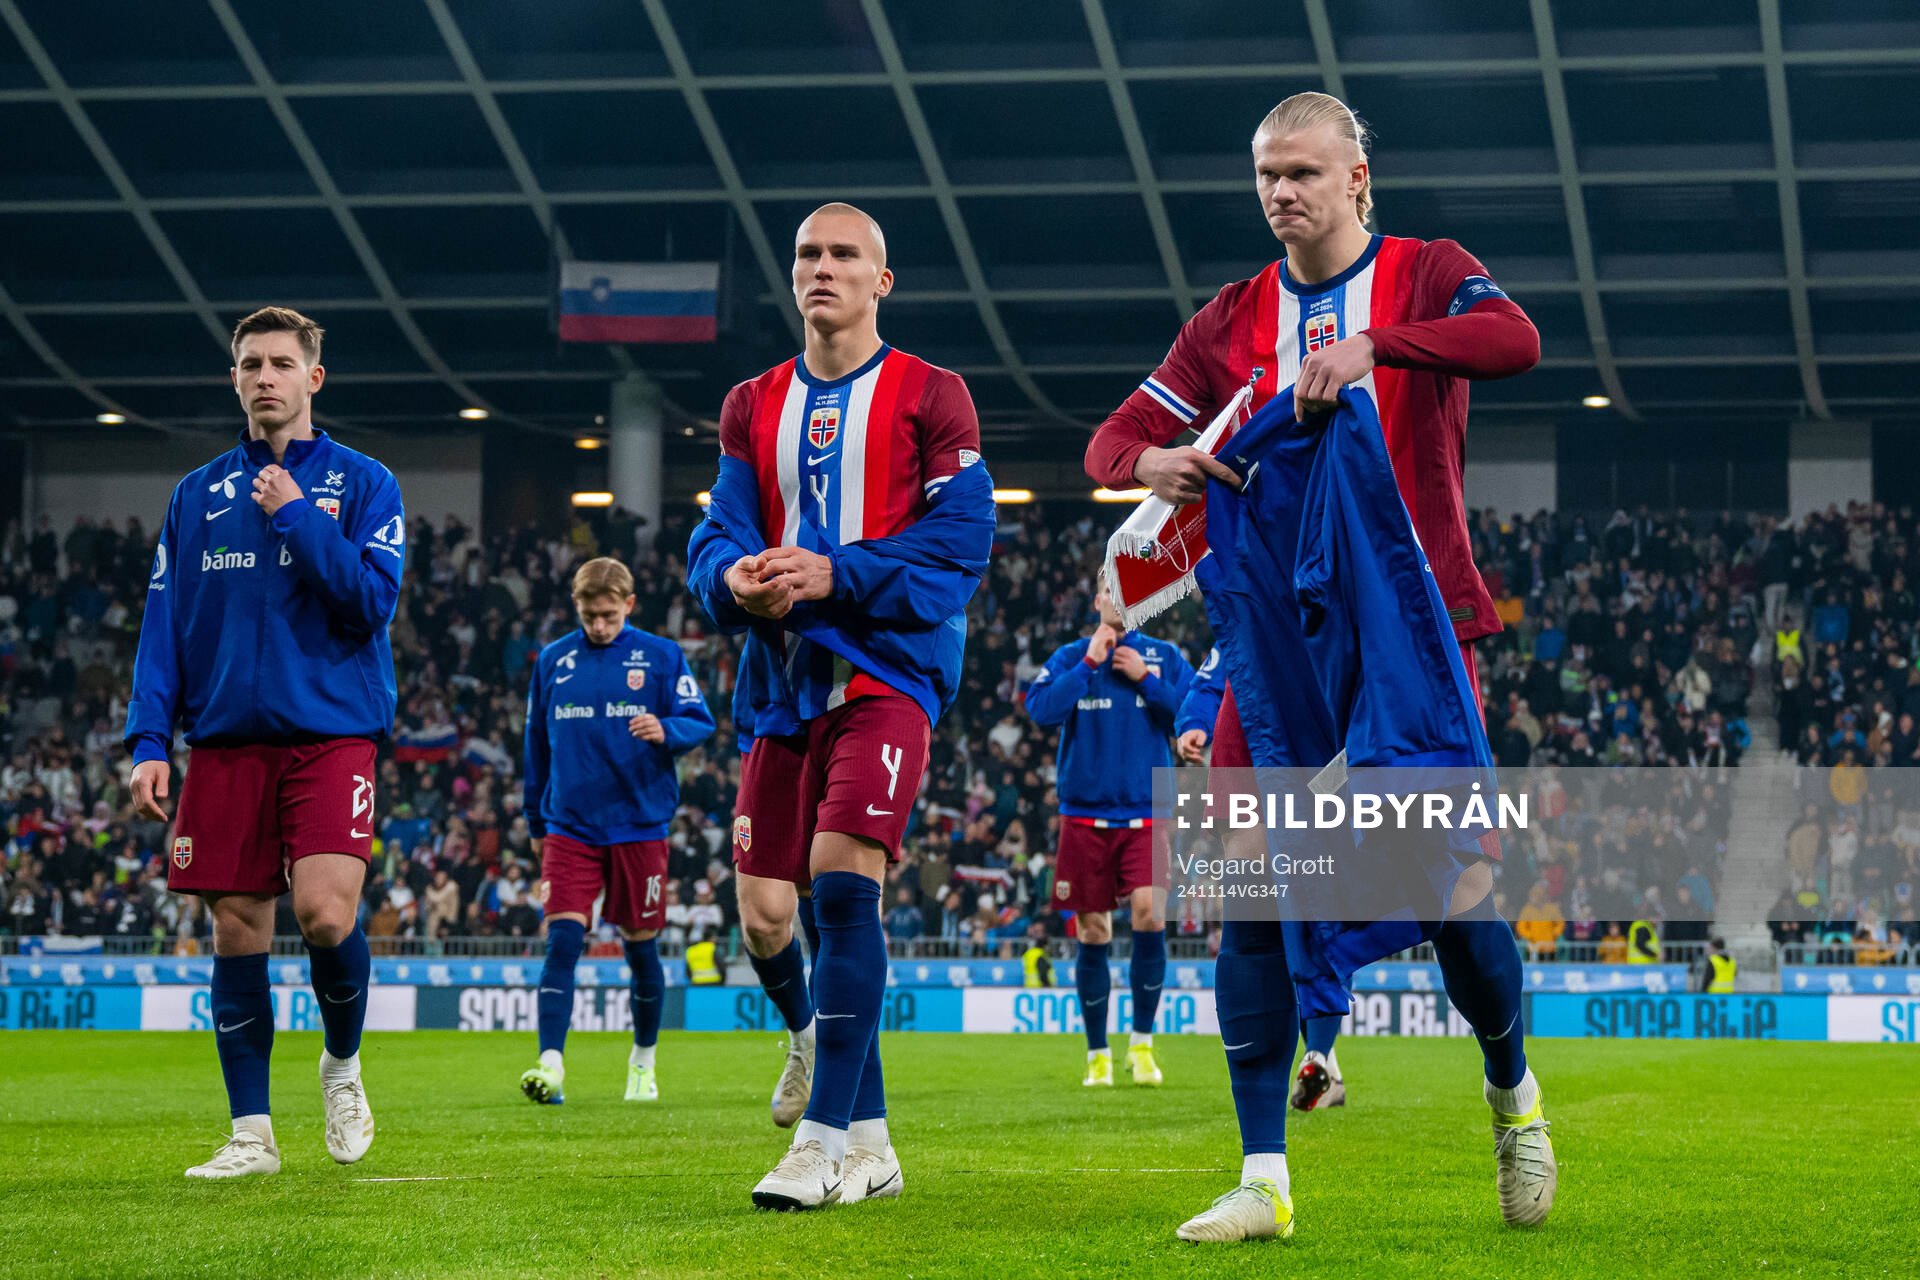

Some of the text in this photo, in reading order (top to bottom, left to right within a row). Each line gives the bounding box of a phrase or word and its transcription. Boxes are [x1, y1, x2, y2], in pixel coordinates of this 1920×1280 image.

[810, 474, 829, 528] 4
[881, 743, 903, 801] 4
[646, 874, 662, 906] 16
